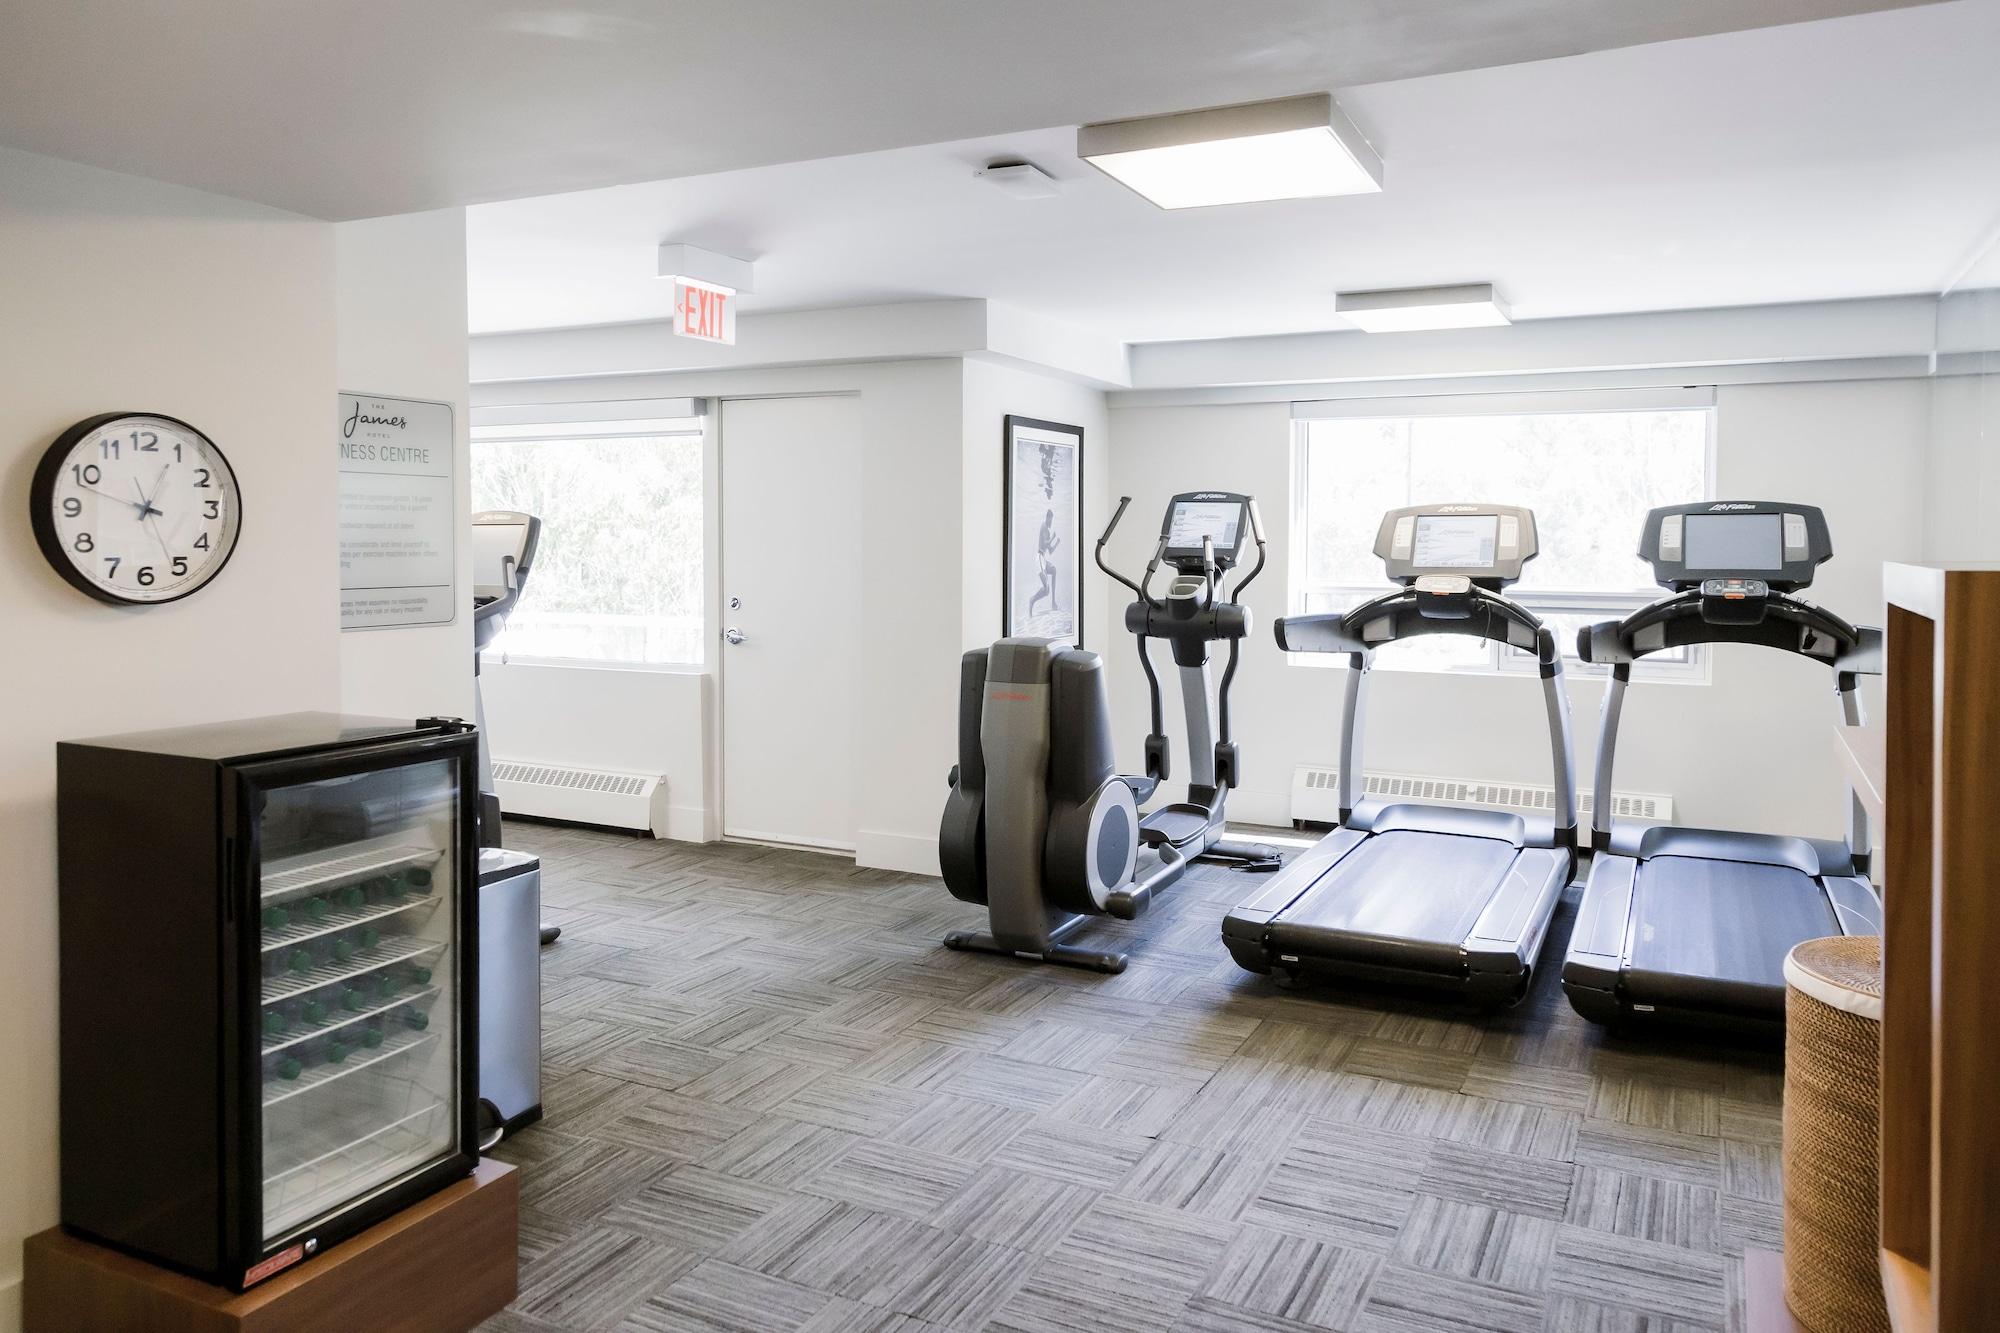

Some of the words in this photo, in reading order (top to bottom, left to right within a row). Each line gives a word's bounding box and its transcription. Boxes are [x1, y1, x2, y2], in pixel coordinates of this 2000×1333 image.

[685, 286, 726, 339] EXIT
[344, 401, 407, 439] James
[100, 439, 120, 460] 11
[129, 431, 159, 452] 12
[173, 443, 182, 463] 1
[339, 443, 376, 461] NESS
[380, 446, 430, 464] CENTRE
[71, 464, 101, 485] 10
[193, 468, 211, 488] 2
[63, 497, 82, 518] 9
[203, 500, 219, 520] 3
[74, 533, 94, 553] 8
[193, 532, 210, 552] 4
[104, 557, 121, 578] 7
[136, 566, 155, 586] 6
[171, 556, 188, 576] 5
